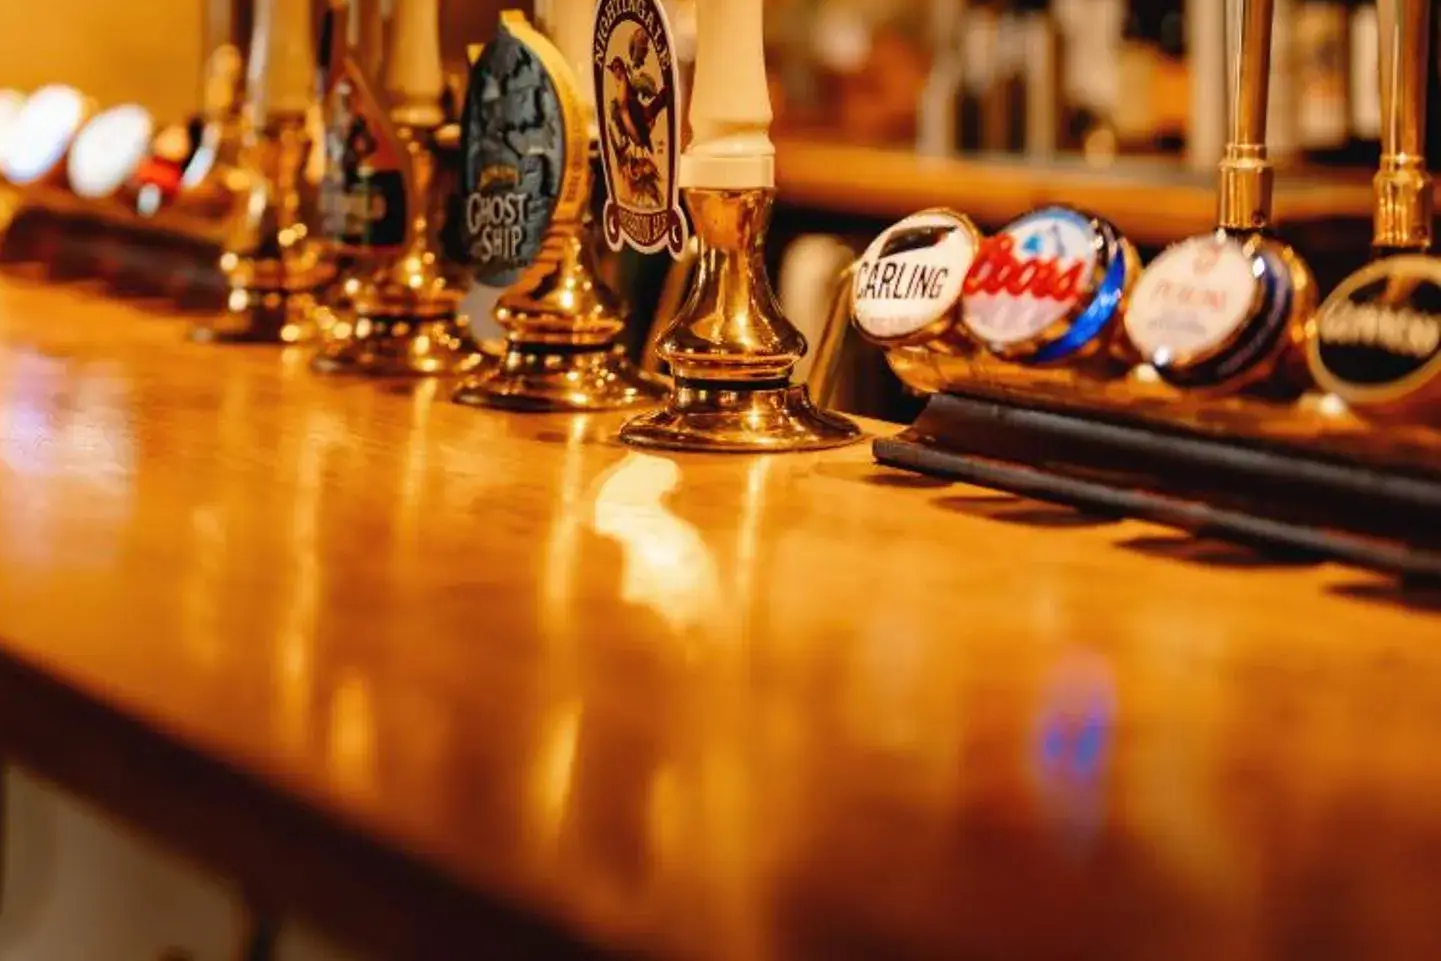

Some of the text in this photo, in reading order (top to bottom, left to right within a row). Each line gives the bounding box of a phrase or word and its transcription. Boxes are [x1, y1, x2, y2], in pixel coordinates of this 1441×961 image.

[467, 192, 528, 235] GHOST
[481, 226, 522, 263] SHIP
[857, 261, 949, 300] CARLING
[962, 232, 1085, 302] Coors
